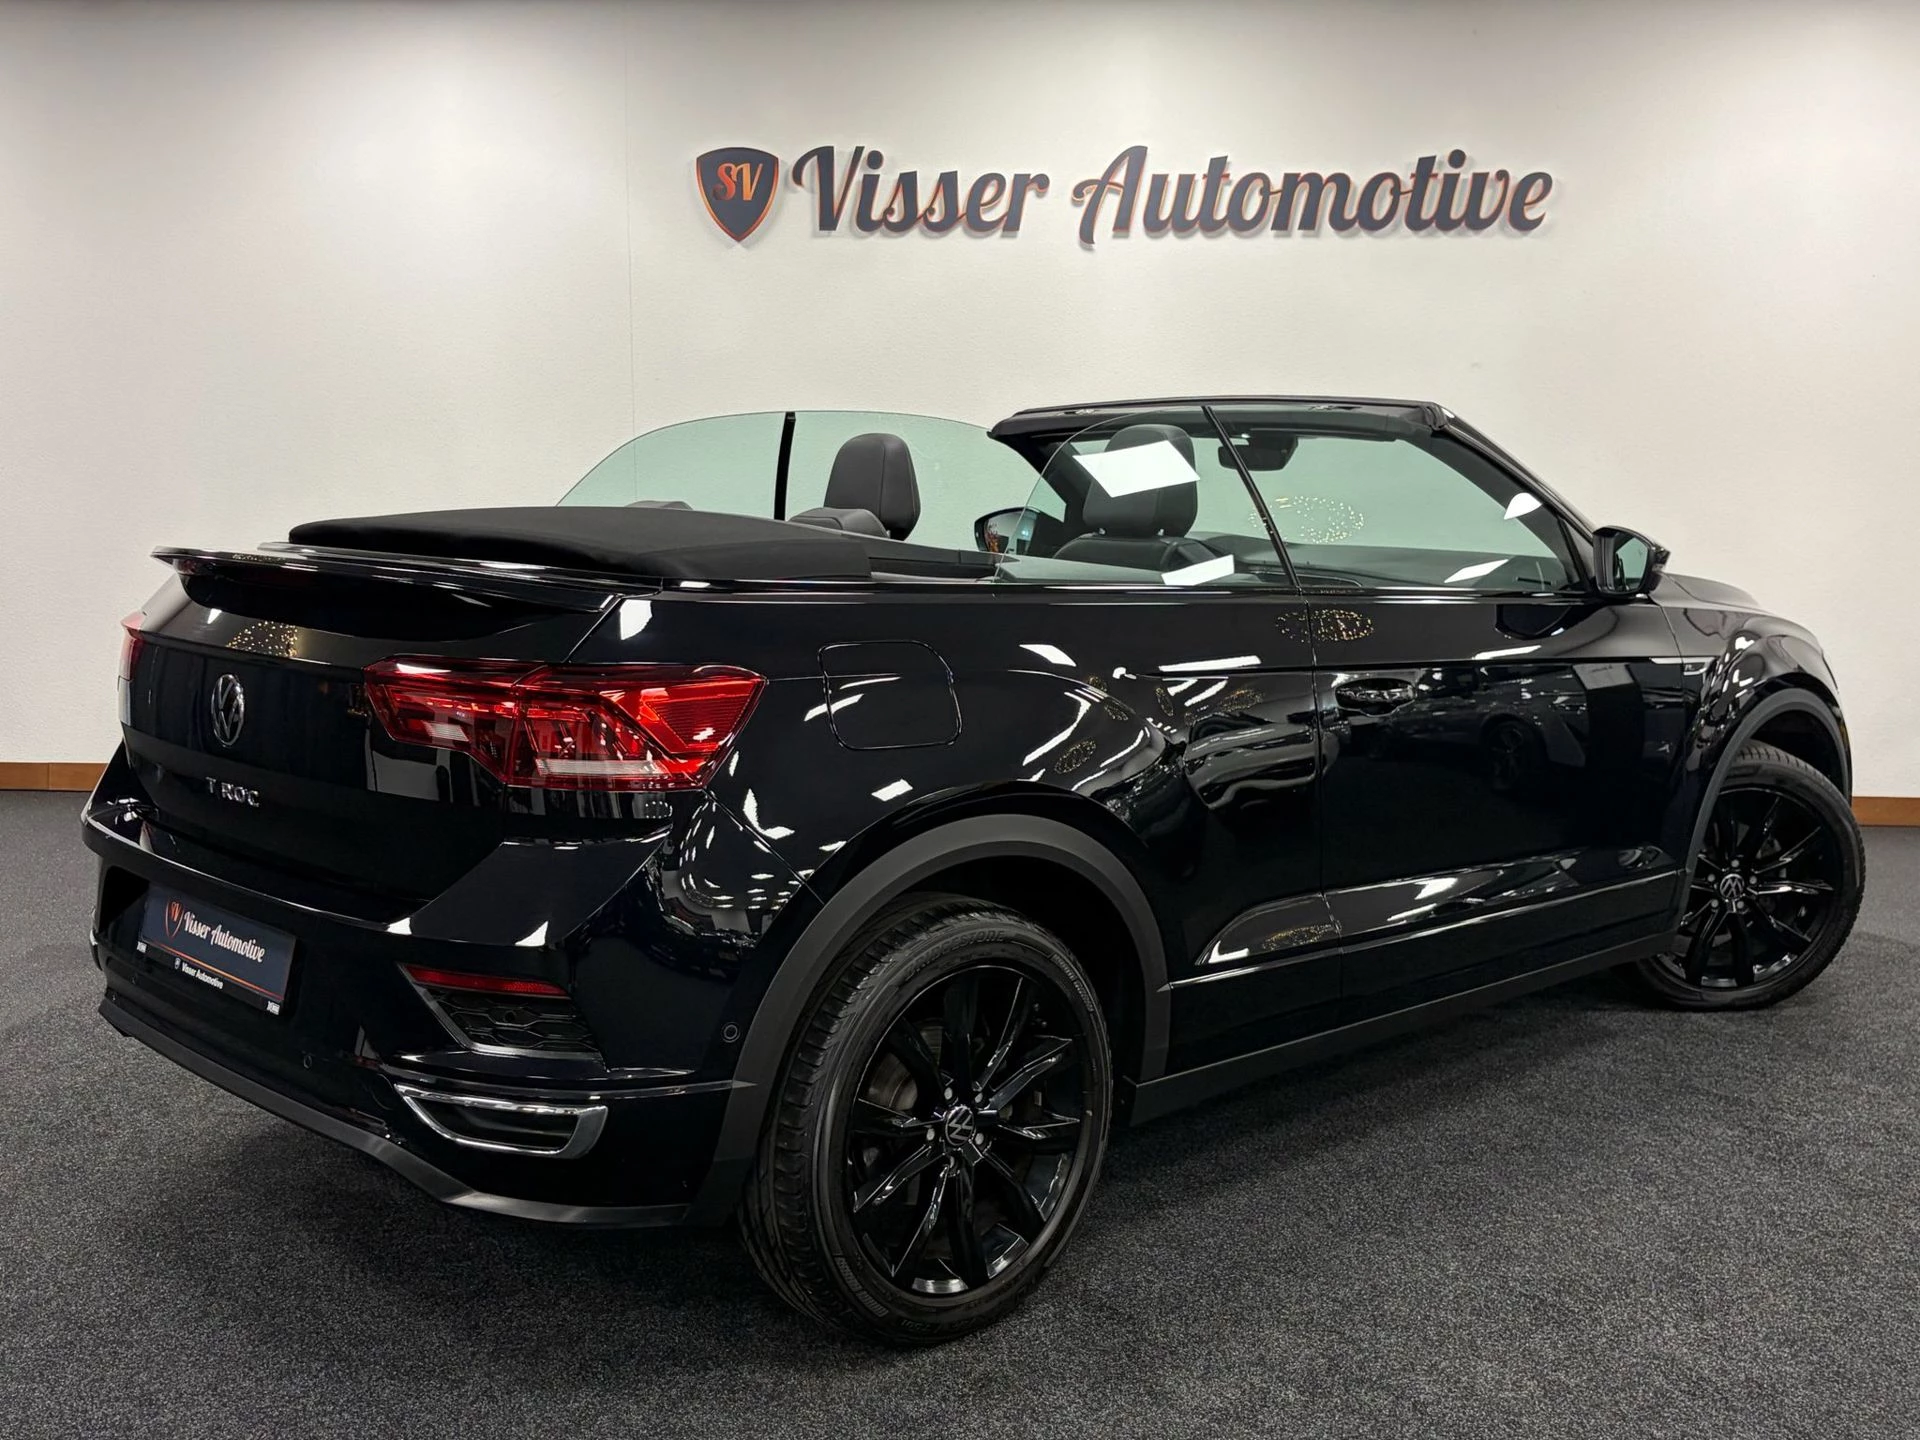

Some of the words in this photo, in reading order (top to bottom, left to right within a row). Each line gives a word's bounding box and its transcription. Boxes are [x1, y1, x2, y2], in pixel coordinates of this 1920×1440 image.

[712, 161, 764, 202] SV
[792, 145, 1051, 232] Visser
[1071, 145, 1553, 245] Automotive
[183, 911, 211, 940] Visser
[210, 924, 266, 963] Automotive
[181, 961, 197, 977] Visser
[195, 969, 224, 990] Automotive
